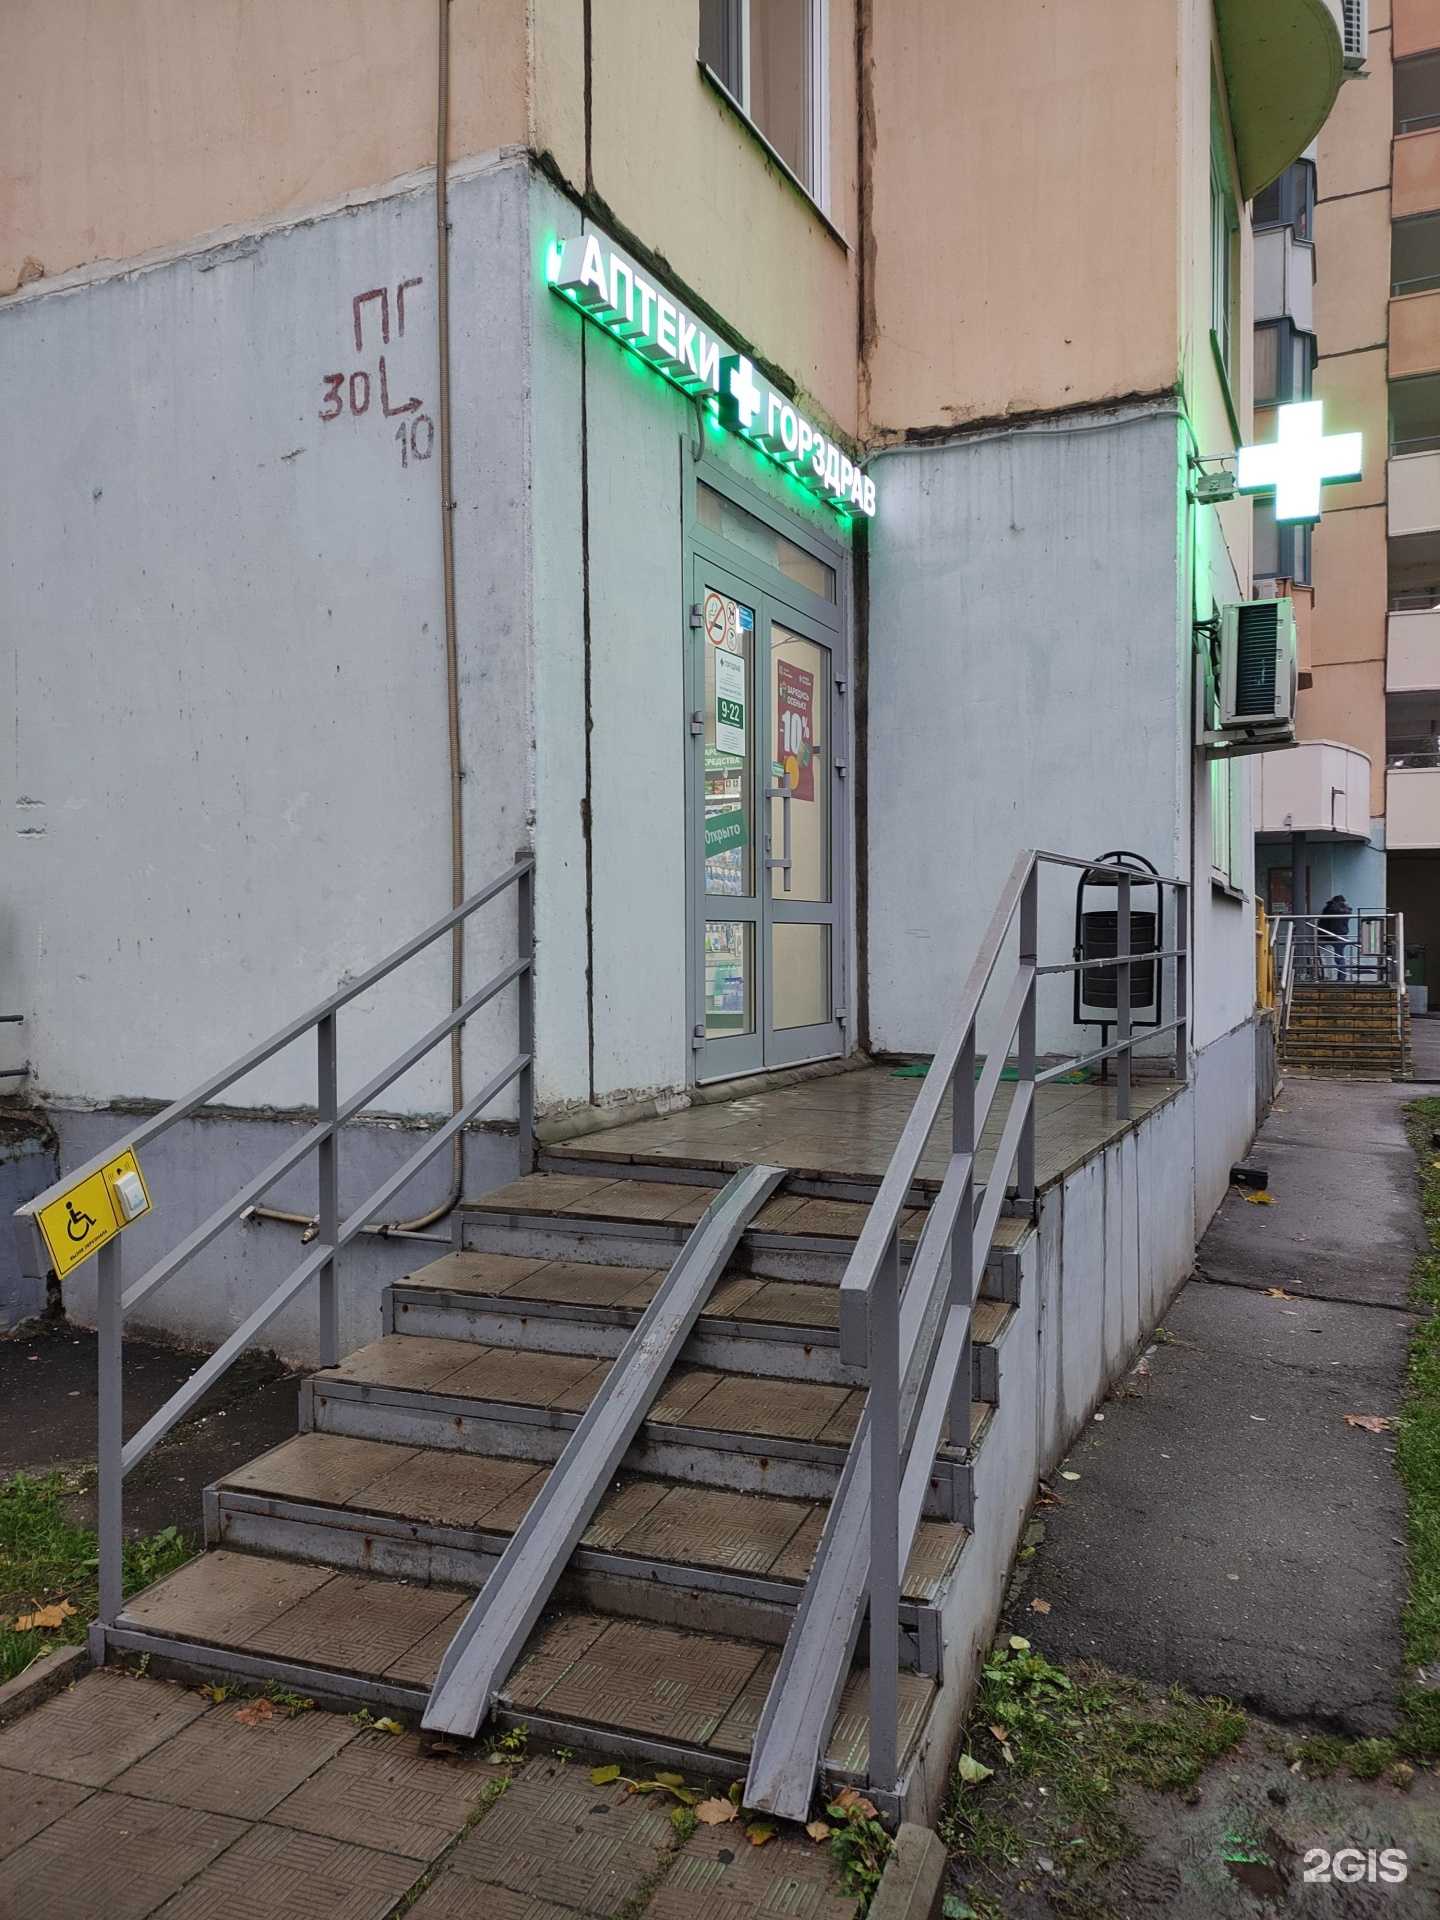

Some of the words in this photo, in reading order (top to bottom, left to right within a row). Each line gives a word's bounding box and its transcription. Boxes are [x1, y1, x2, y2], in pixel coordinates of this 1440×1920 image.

[580, 234, 721, 392] АПТЕКИ
[766, 390, 877, 517] ГОРЗДРАВ
[394, 413, 435, 469] 10
[721, 700, 740, 722] 9-22
[704, 822, 741, 845] Открыто
